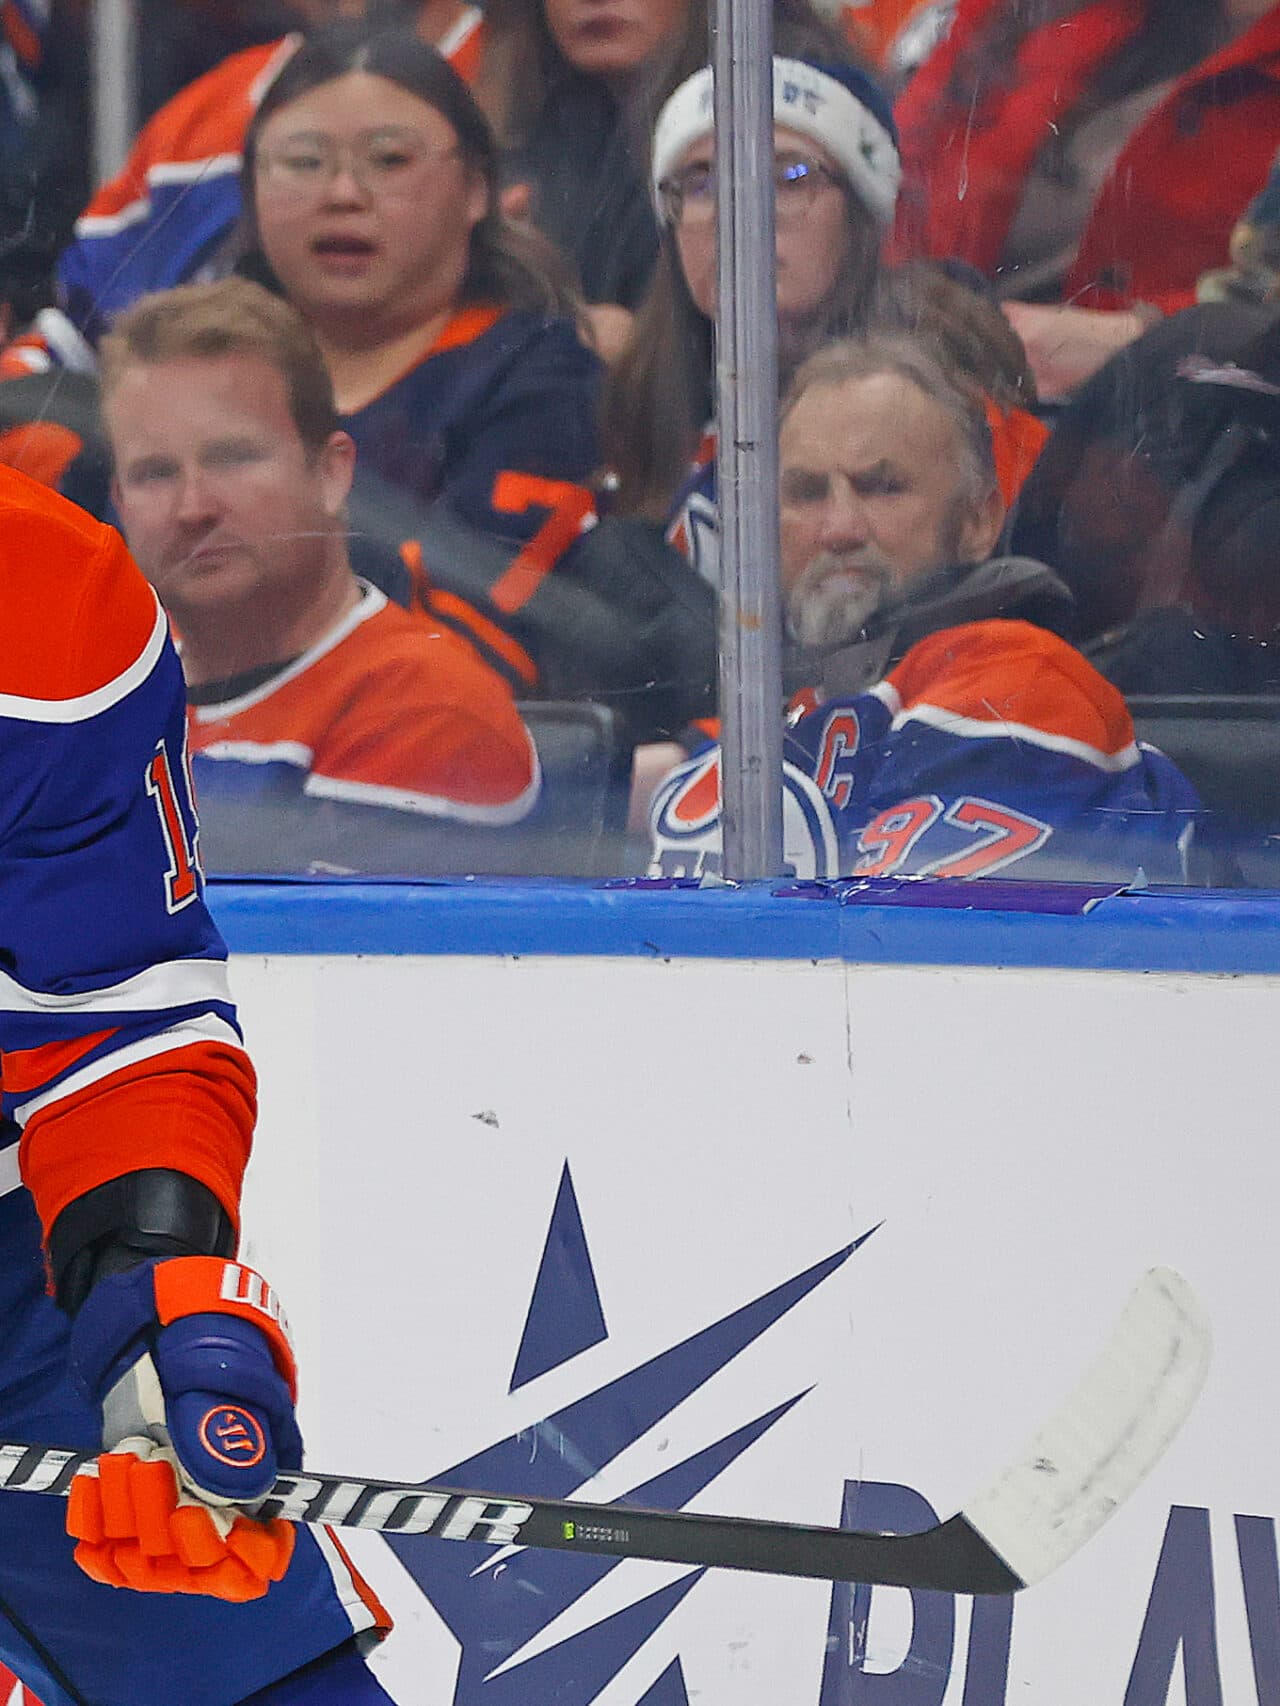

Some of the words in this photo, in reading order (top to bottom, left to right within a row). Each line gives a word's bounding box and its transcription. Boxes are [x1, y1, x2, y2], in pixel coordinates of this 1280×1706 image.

[490, 469, 597, 614] 7
[817, 707, 860, 810] C
[145, 738, 207, 915] 1
[851, 794, 1055, 881] 97
